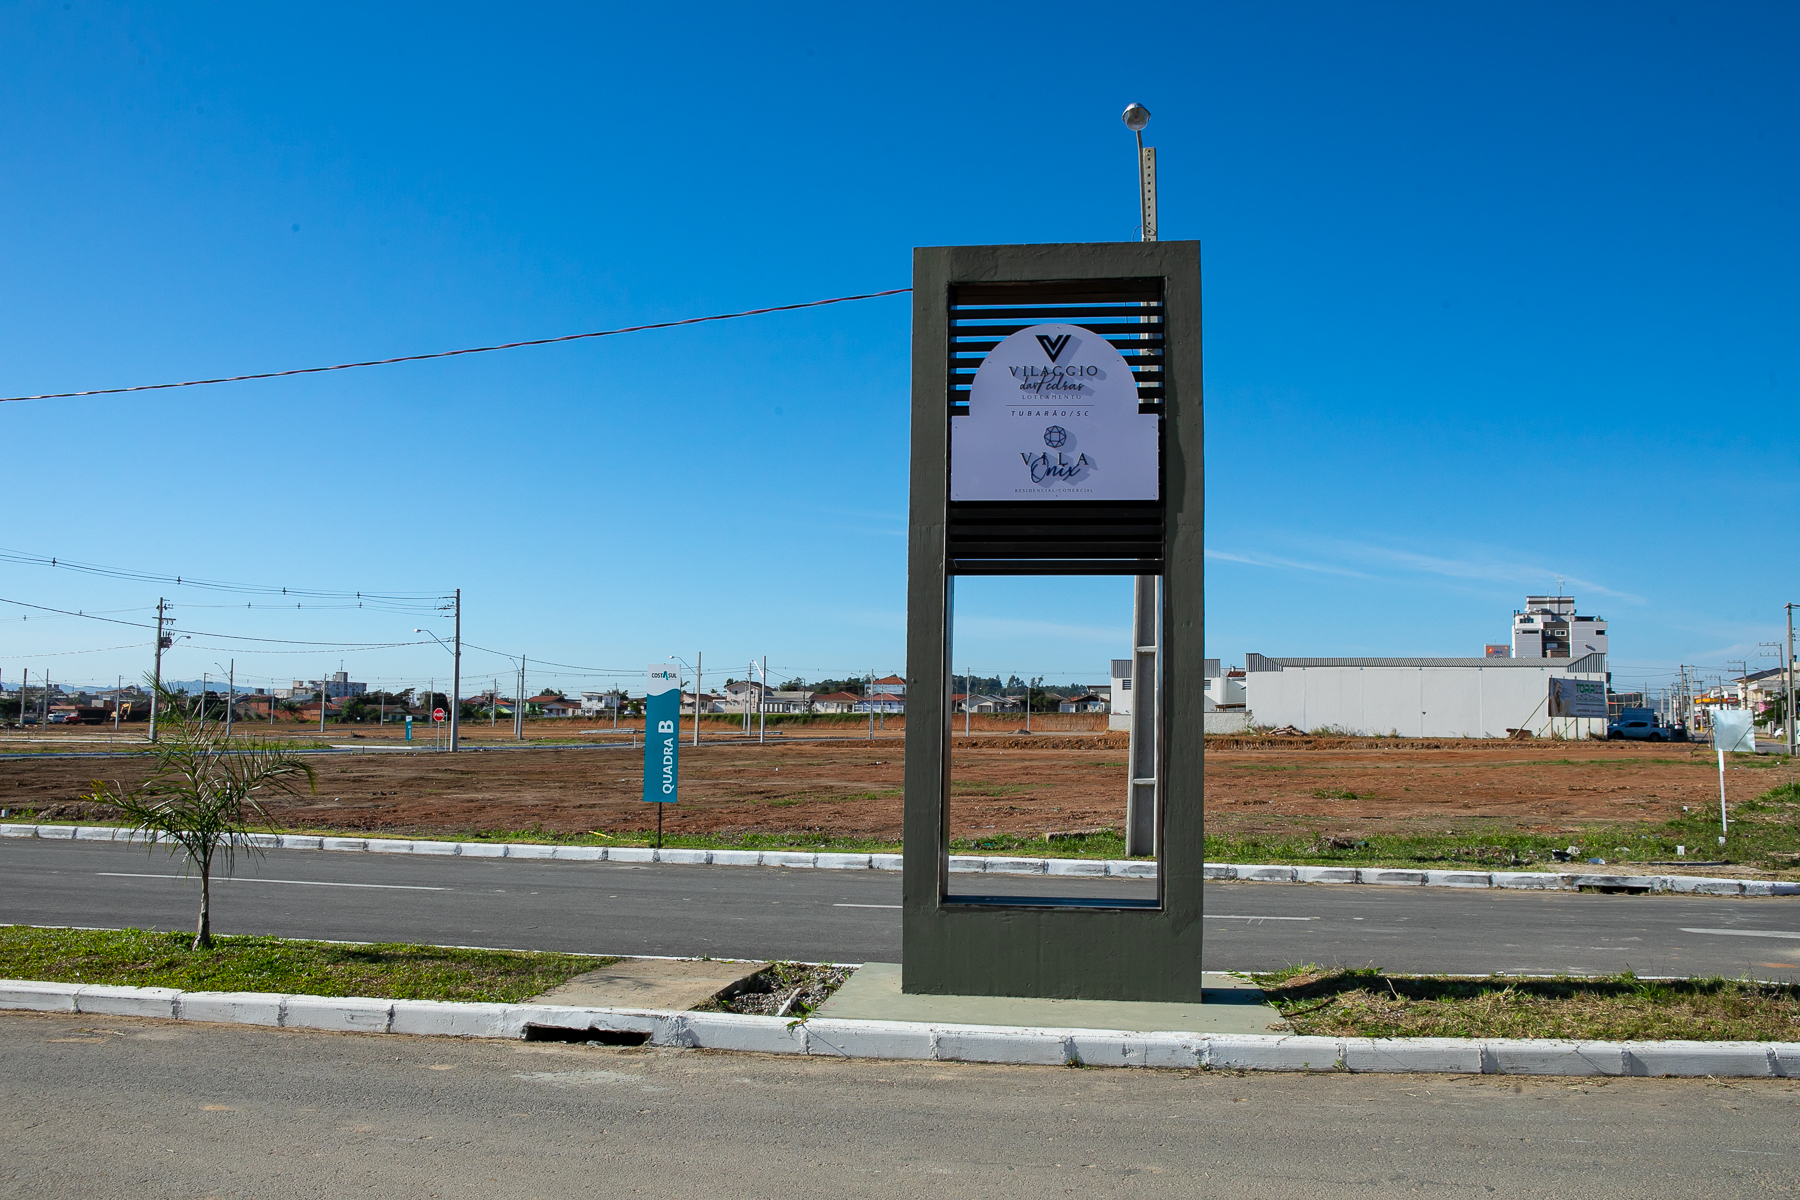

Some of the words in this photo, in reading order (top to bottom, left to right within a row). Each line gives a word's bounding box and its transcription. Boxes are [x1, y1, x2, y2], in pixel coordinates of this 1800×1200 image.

[1008, 365, 1098, 377] VILAGGIO
[1020, 451, 1089, 466] VILA
[657, 719, 674, 734] B
[662, 737, 675, 794] QUADRA
